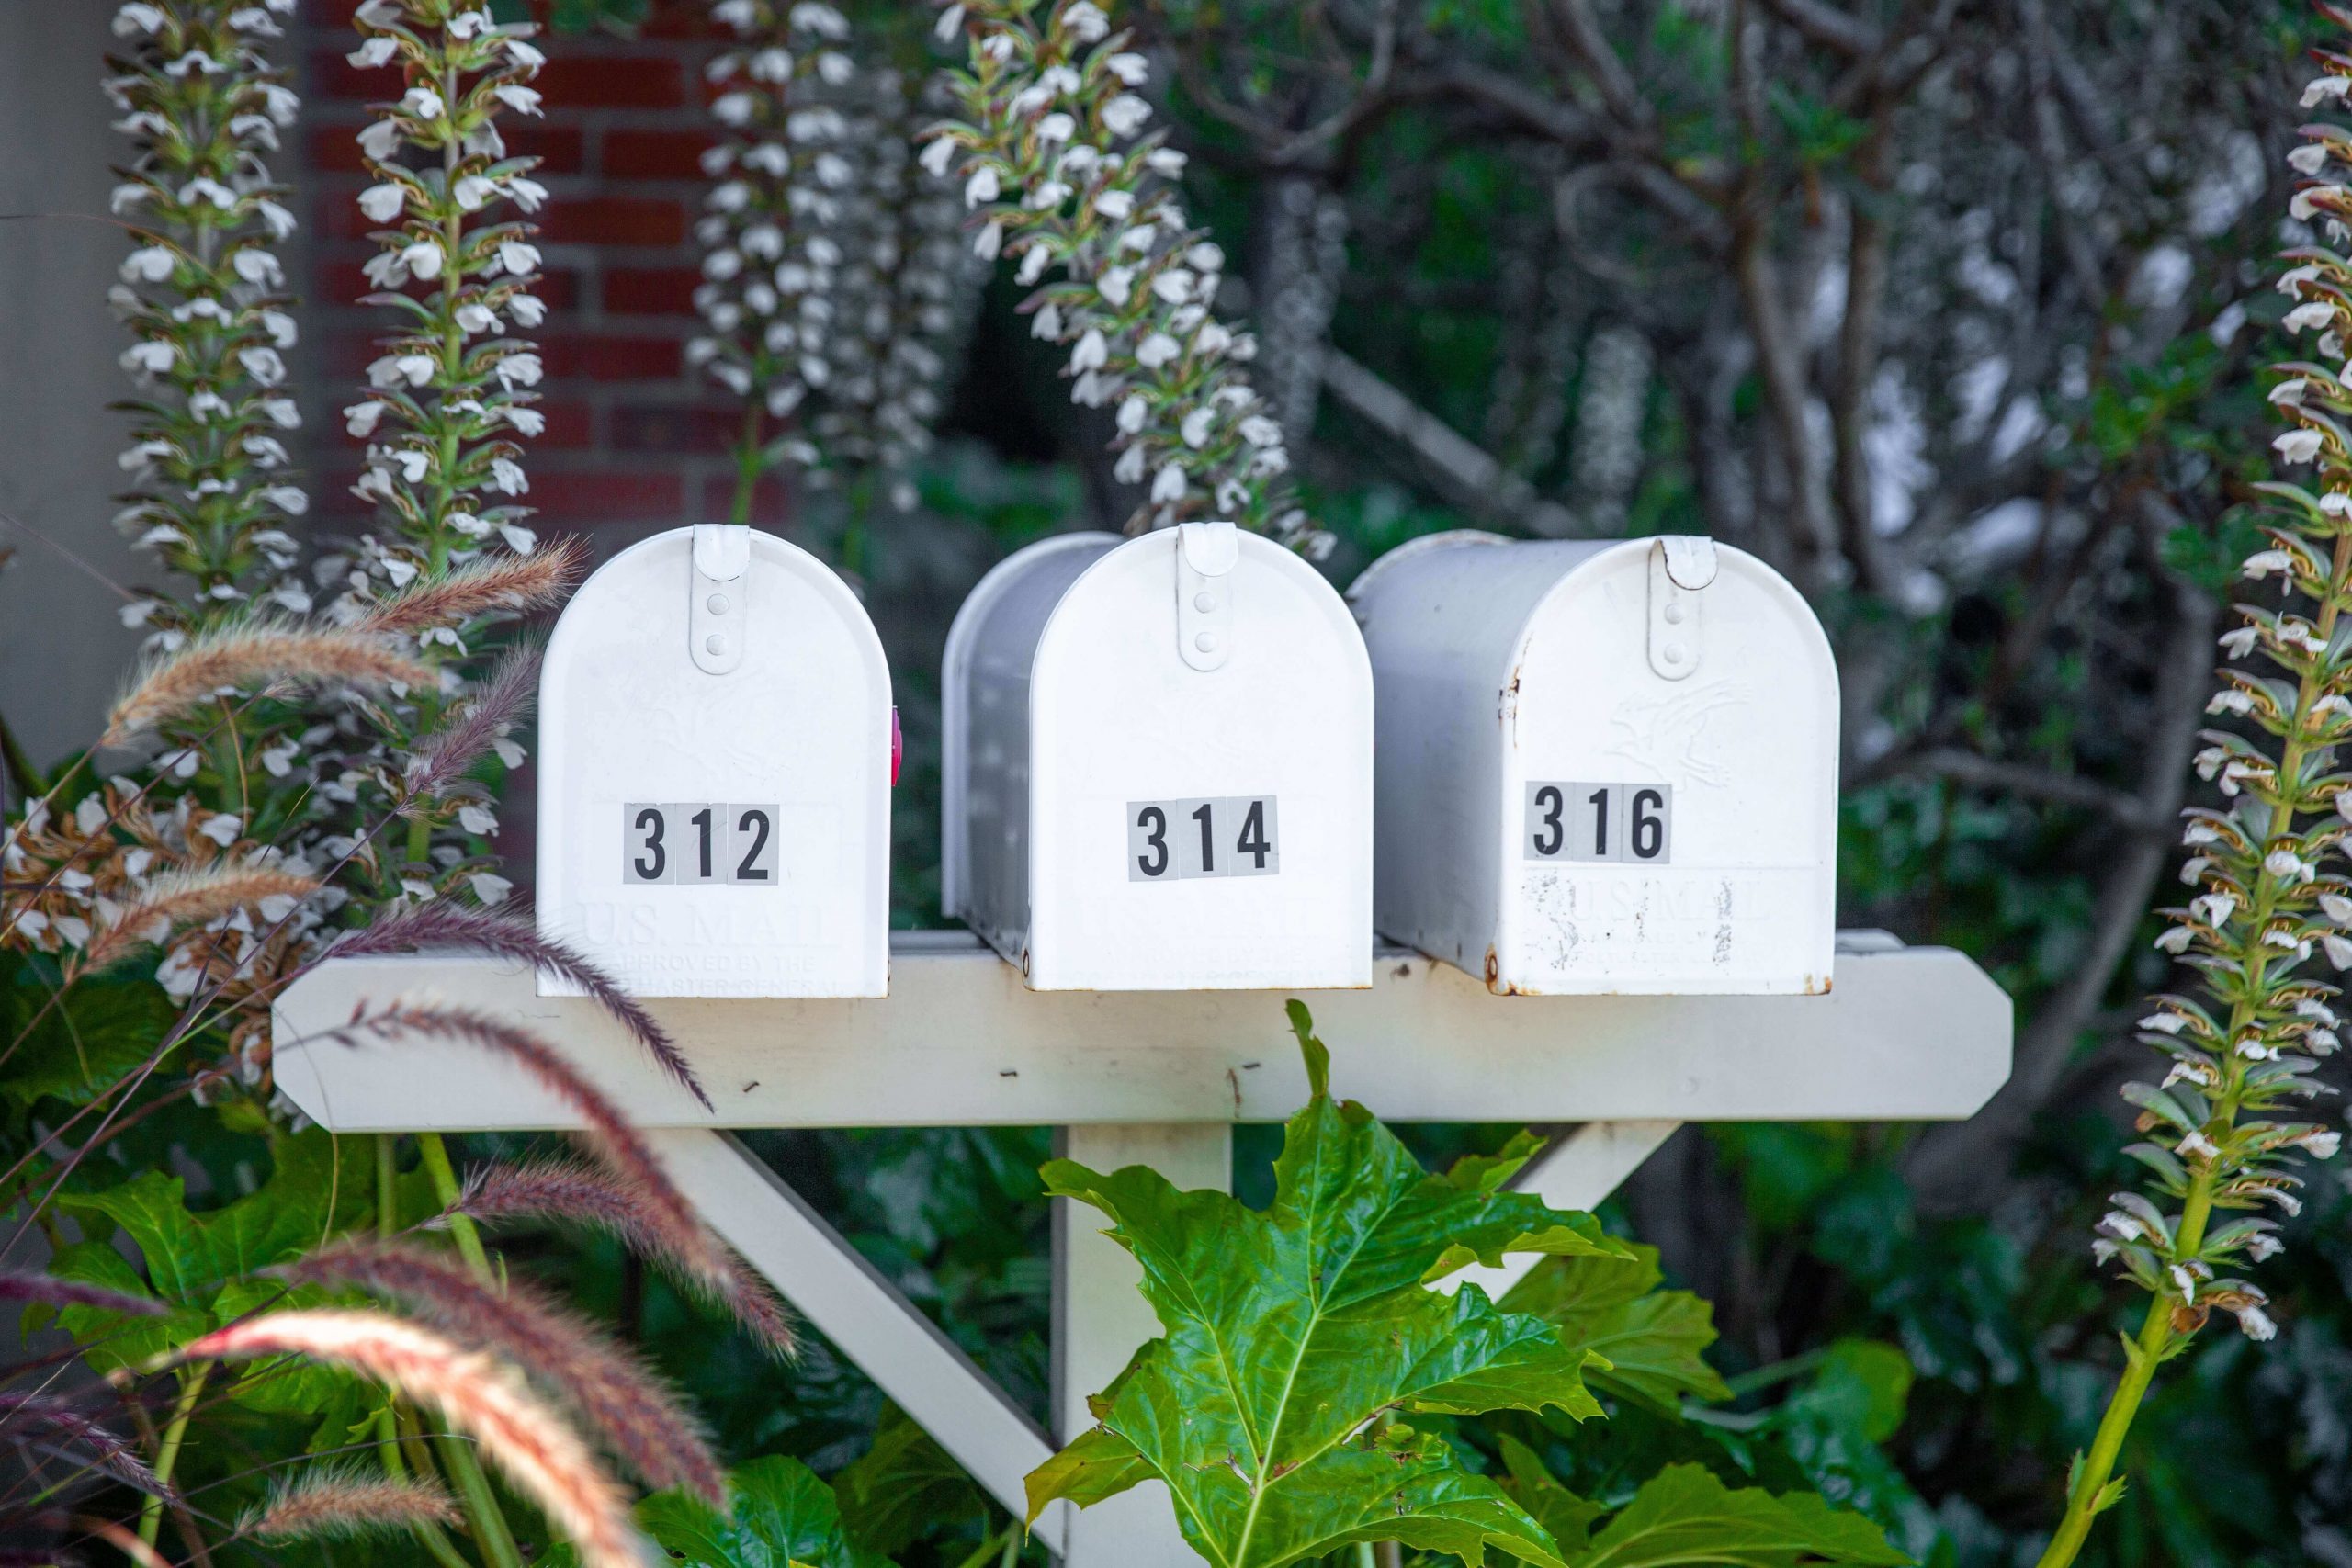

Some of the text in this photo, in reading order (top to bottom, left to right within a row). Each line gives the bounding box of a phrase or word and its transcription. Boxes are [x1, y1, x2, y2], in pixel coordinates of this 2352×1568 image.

[634, 808, 770, 880] 312
[1137, 800, 1271, 876] 314
[1533, 786, 1664, 858] 316
[684, 901, 842, 948] MAIL
[1655, 881, 1769, 921] MAL
[774, 954, 817, 973] THE
